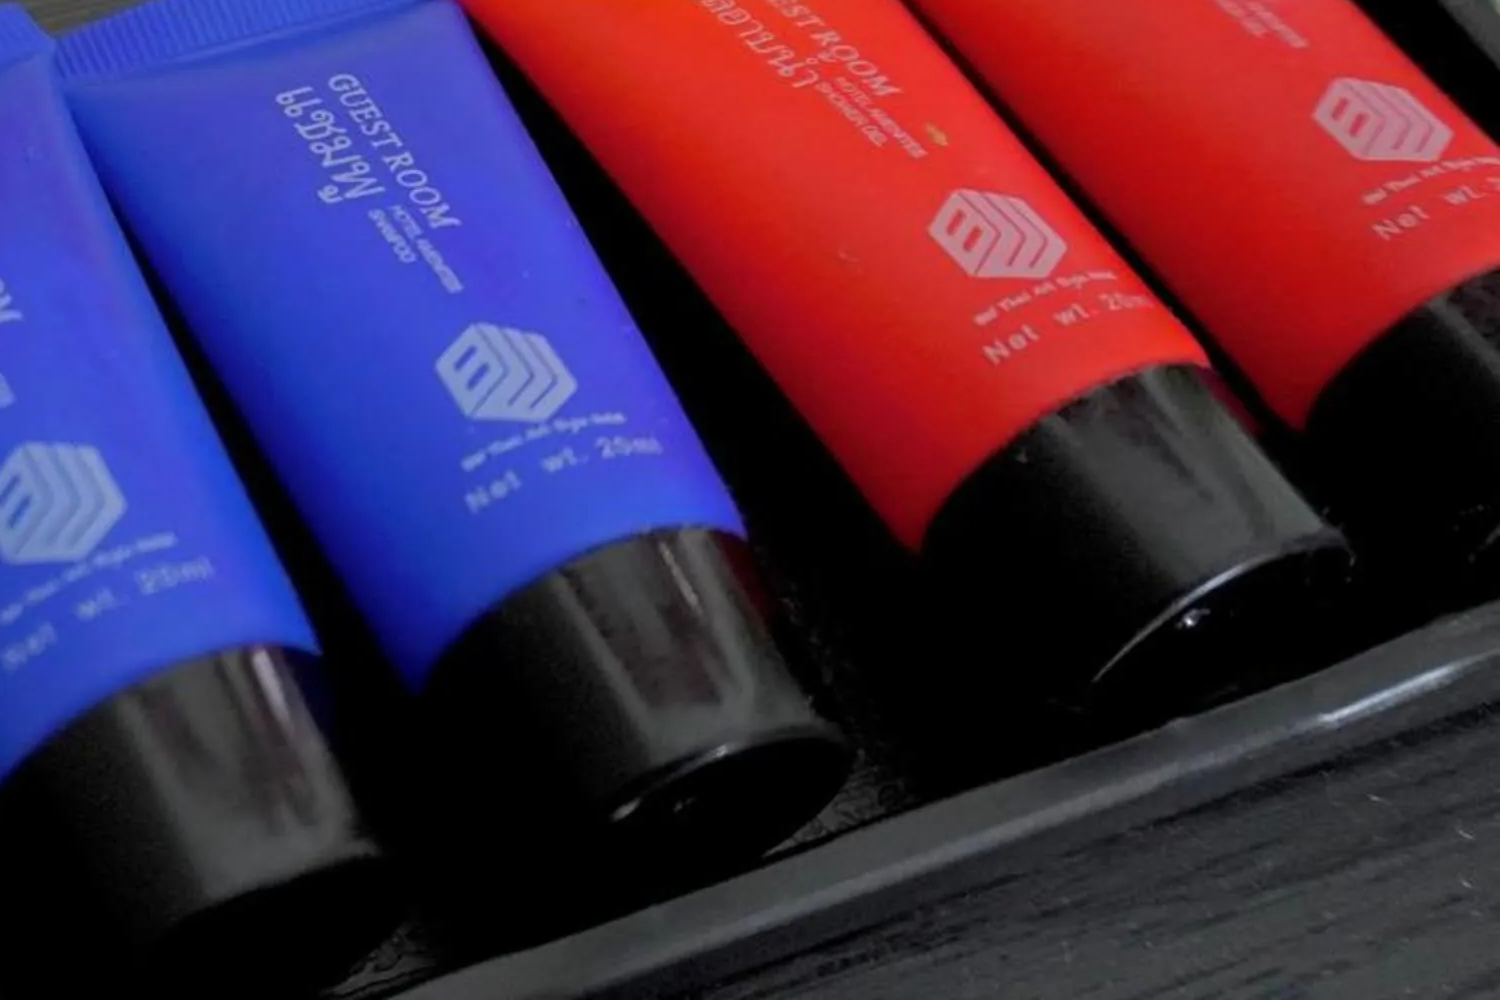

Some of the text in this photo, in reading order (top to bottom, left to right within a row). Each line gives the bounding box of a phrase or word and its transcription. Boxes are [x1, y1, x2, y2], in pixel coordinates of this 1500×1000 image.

[811, 29, 902, 97] ROOM
[275, 86, 386, 204] แชมพู
[328, 73, 404, 149] GUEST
[382, 151, 463, 229] ROOM
